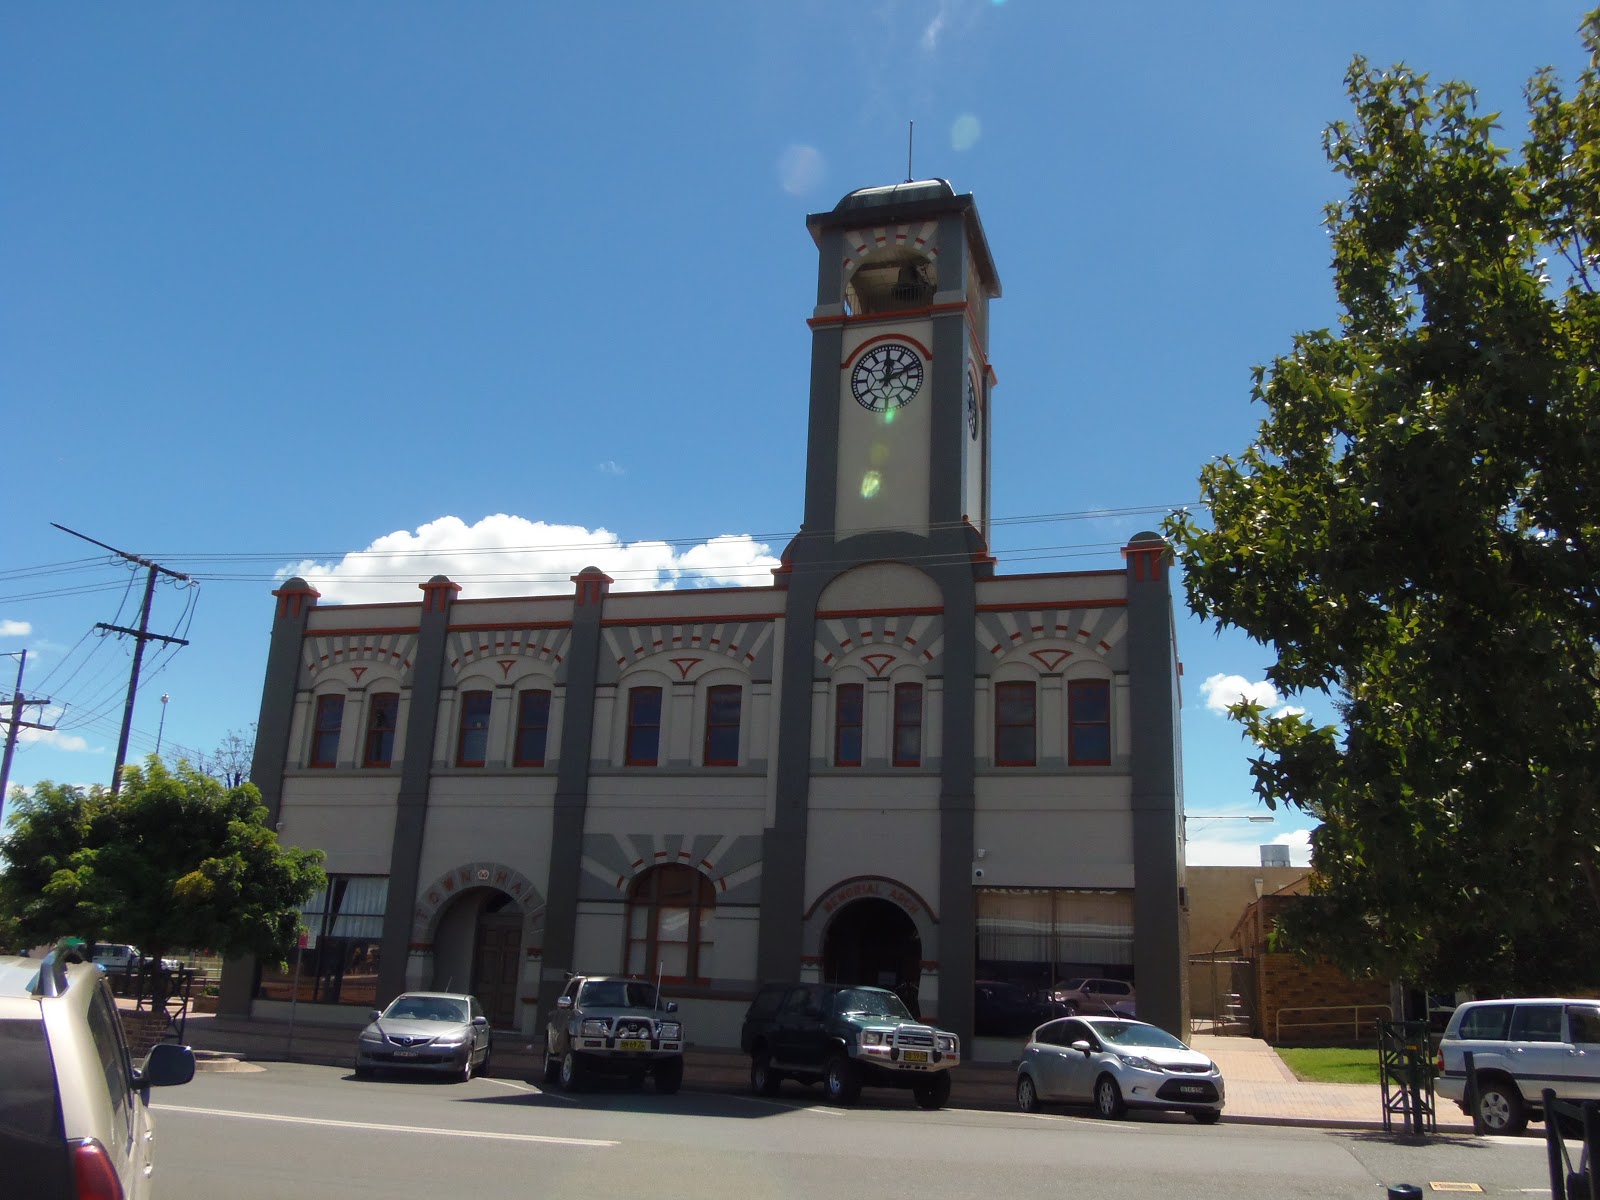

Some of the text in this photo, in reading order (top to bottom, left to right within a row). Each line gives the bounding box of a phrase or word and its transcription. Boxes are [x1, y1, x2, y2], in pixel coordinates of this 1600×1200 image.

[415, 870, 545, 923] TOWN HALL
[823, 883, 921, 914] MEMORIAL ARCH
